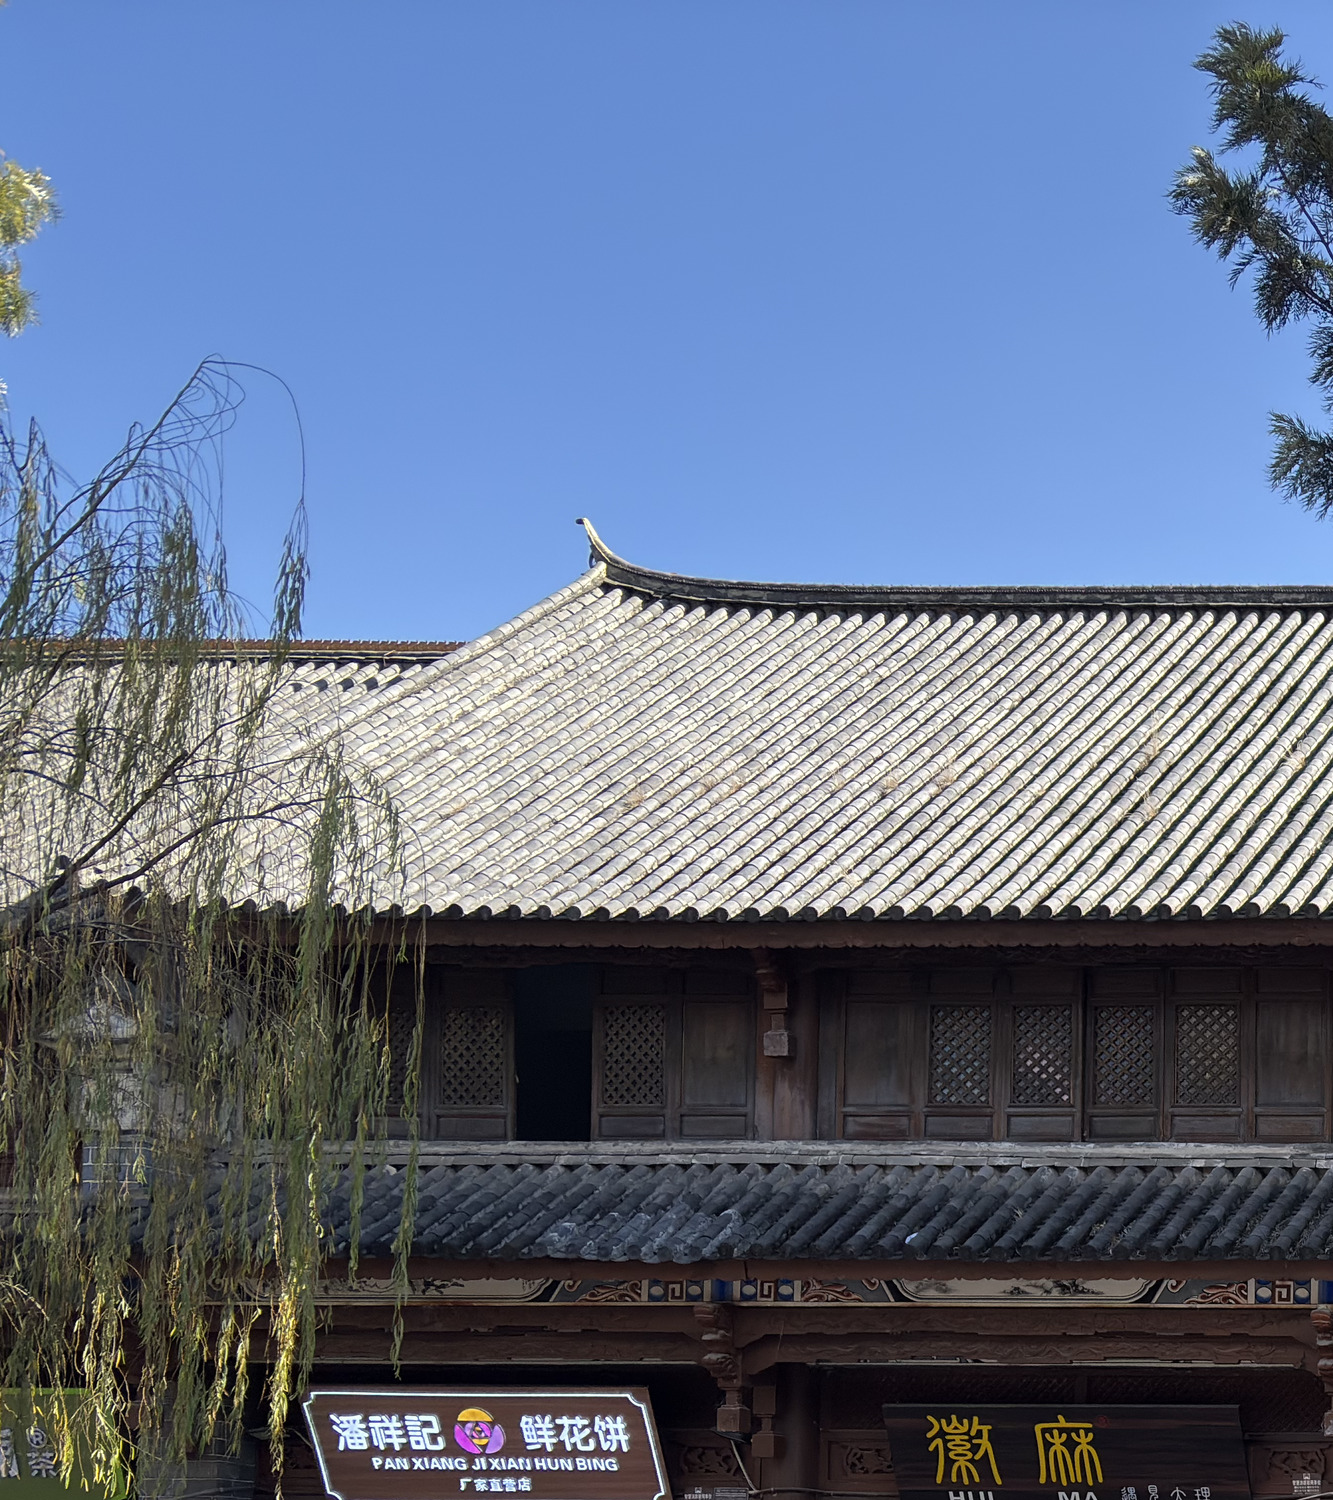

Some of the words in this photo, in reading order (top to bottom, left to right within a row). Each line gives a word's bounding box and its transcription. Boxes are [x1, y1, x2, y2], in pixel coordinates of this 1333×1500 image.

[329, 1413, 445, 1453] 潘祥記
[519, 1414, 631, 1454] 鲜花饼
[372, 1457, 408, 1471] PAN
[412, 1457, 467, 1471] XIANG
[534, 1457, 573, 1471] HUN
[576, 1457, 619, 1471] BING
[460, 1477, 532, 1492] 厂家直营店
